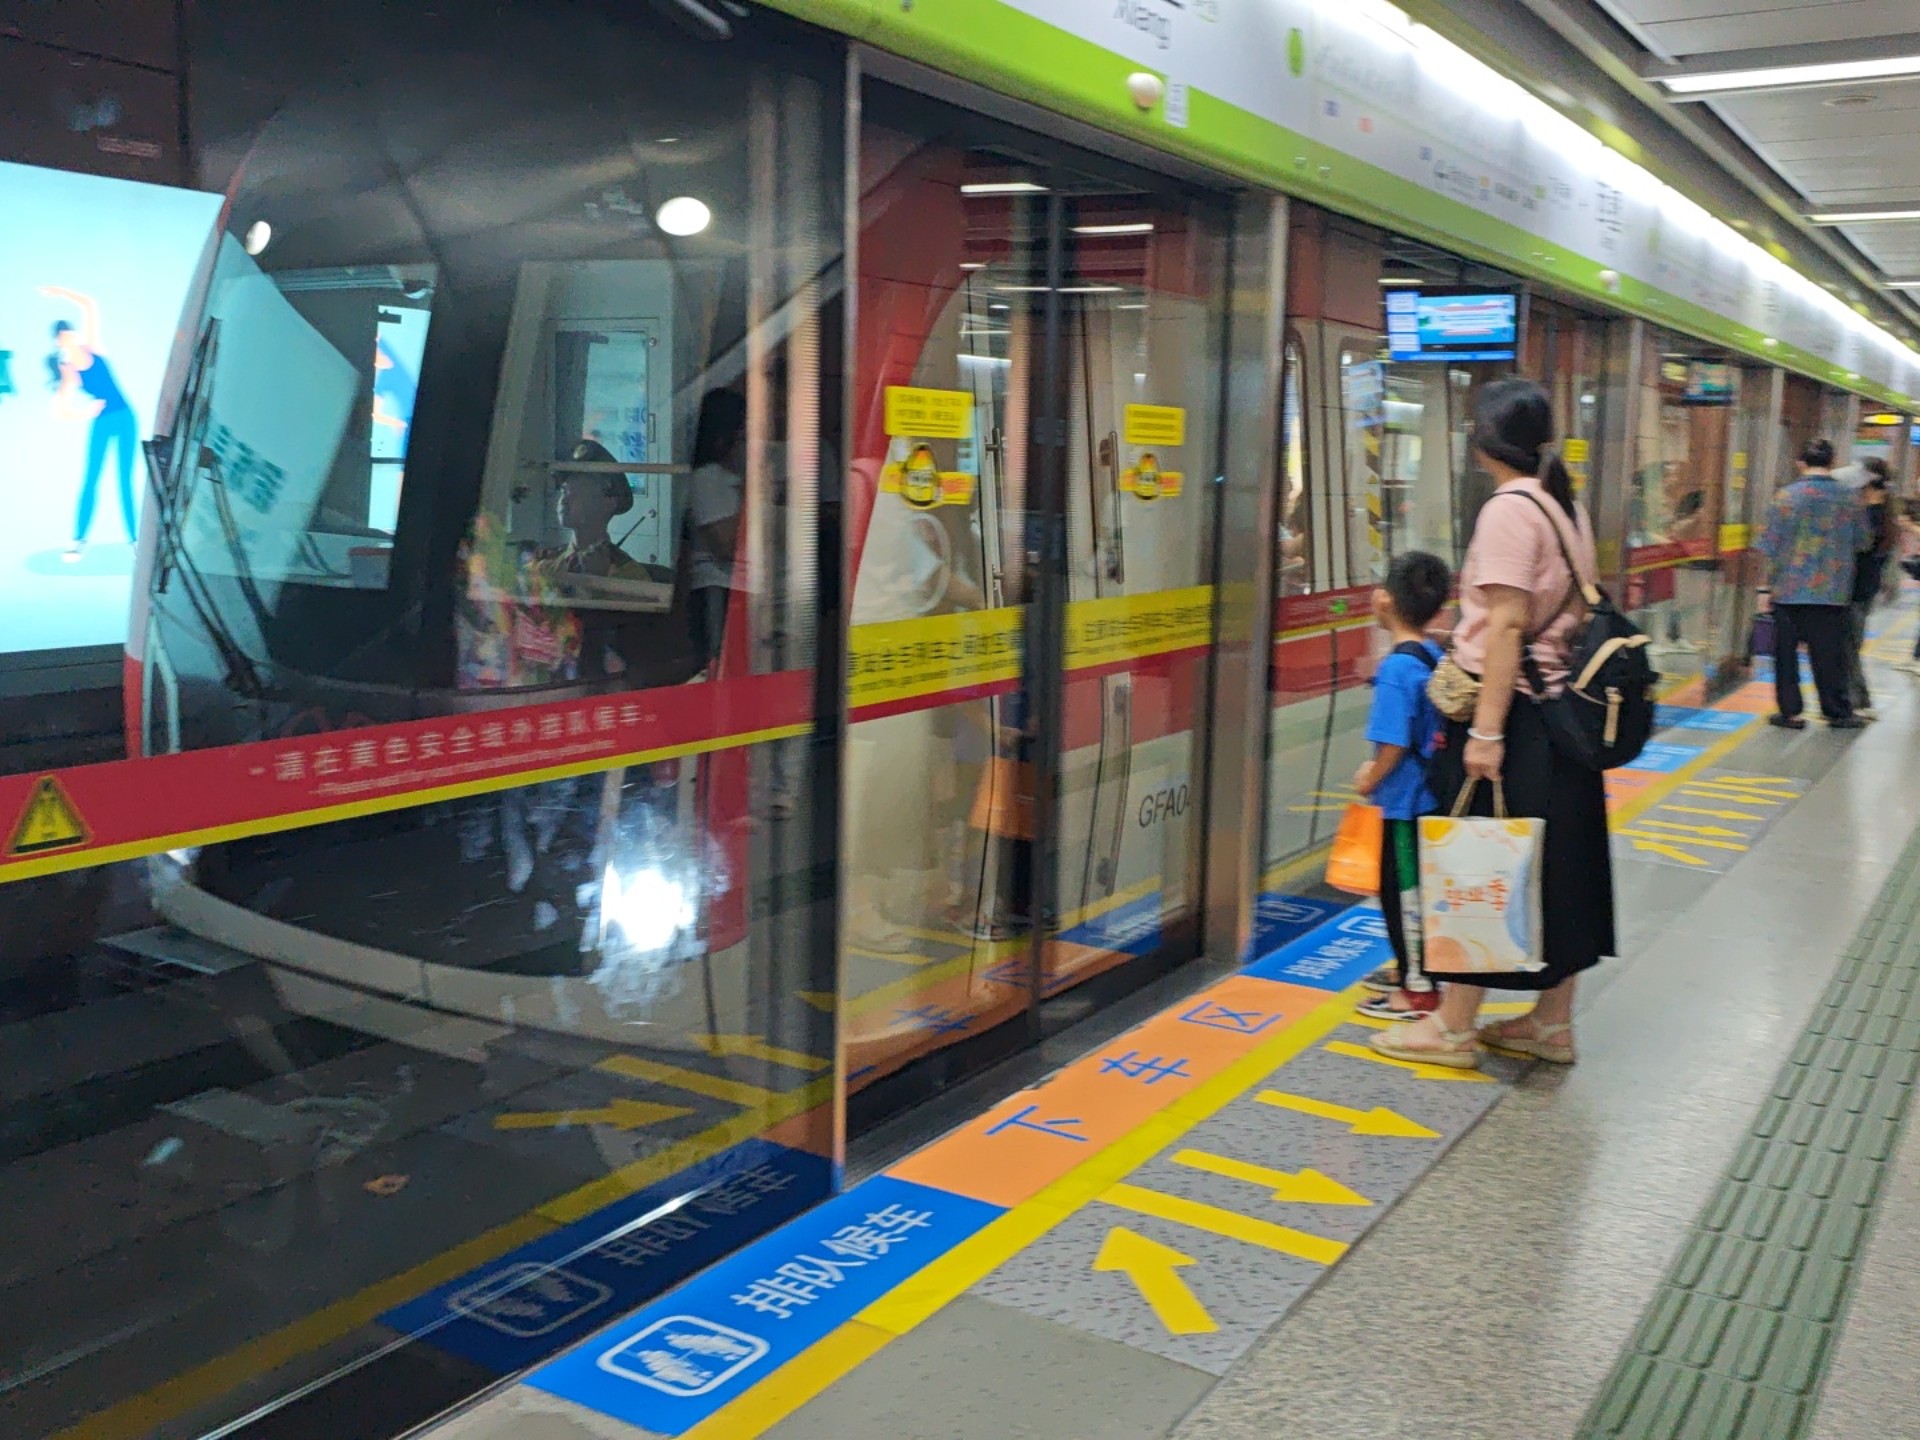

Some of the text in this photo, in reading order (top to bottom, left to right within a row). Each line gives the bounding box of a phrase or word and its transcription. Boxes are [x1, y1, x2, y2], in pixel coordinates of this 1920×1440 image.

[1139, 784, 1190, 828] GFA0
[985, 1000, 1285, 1142] 下车区
[730, 1203, 934, 1319] 排队候车
